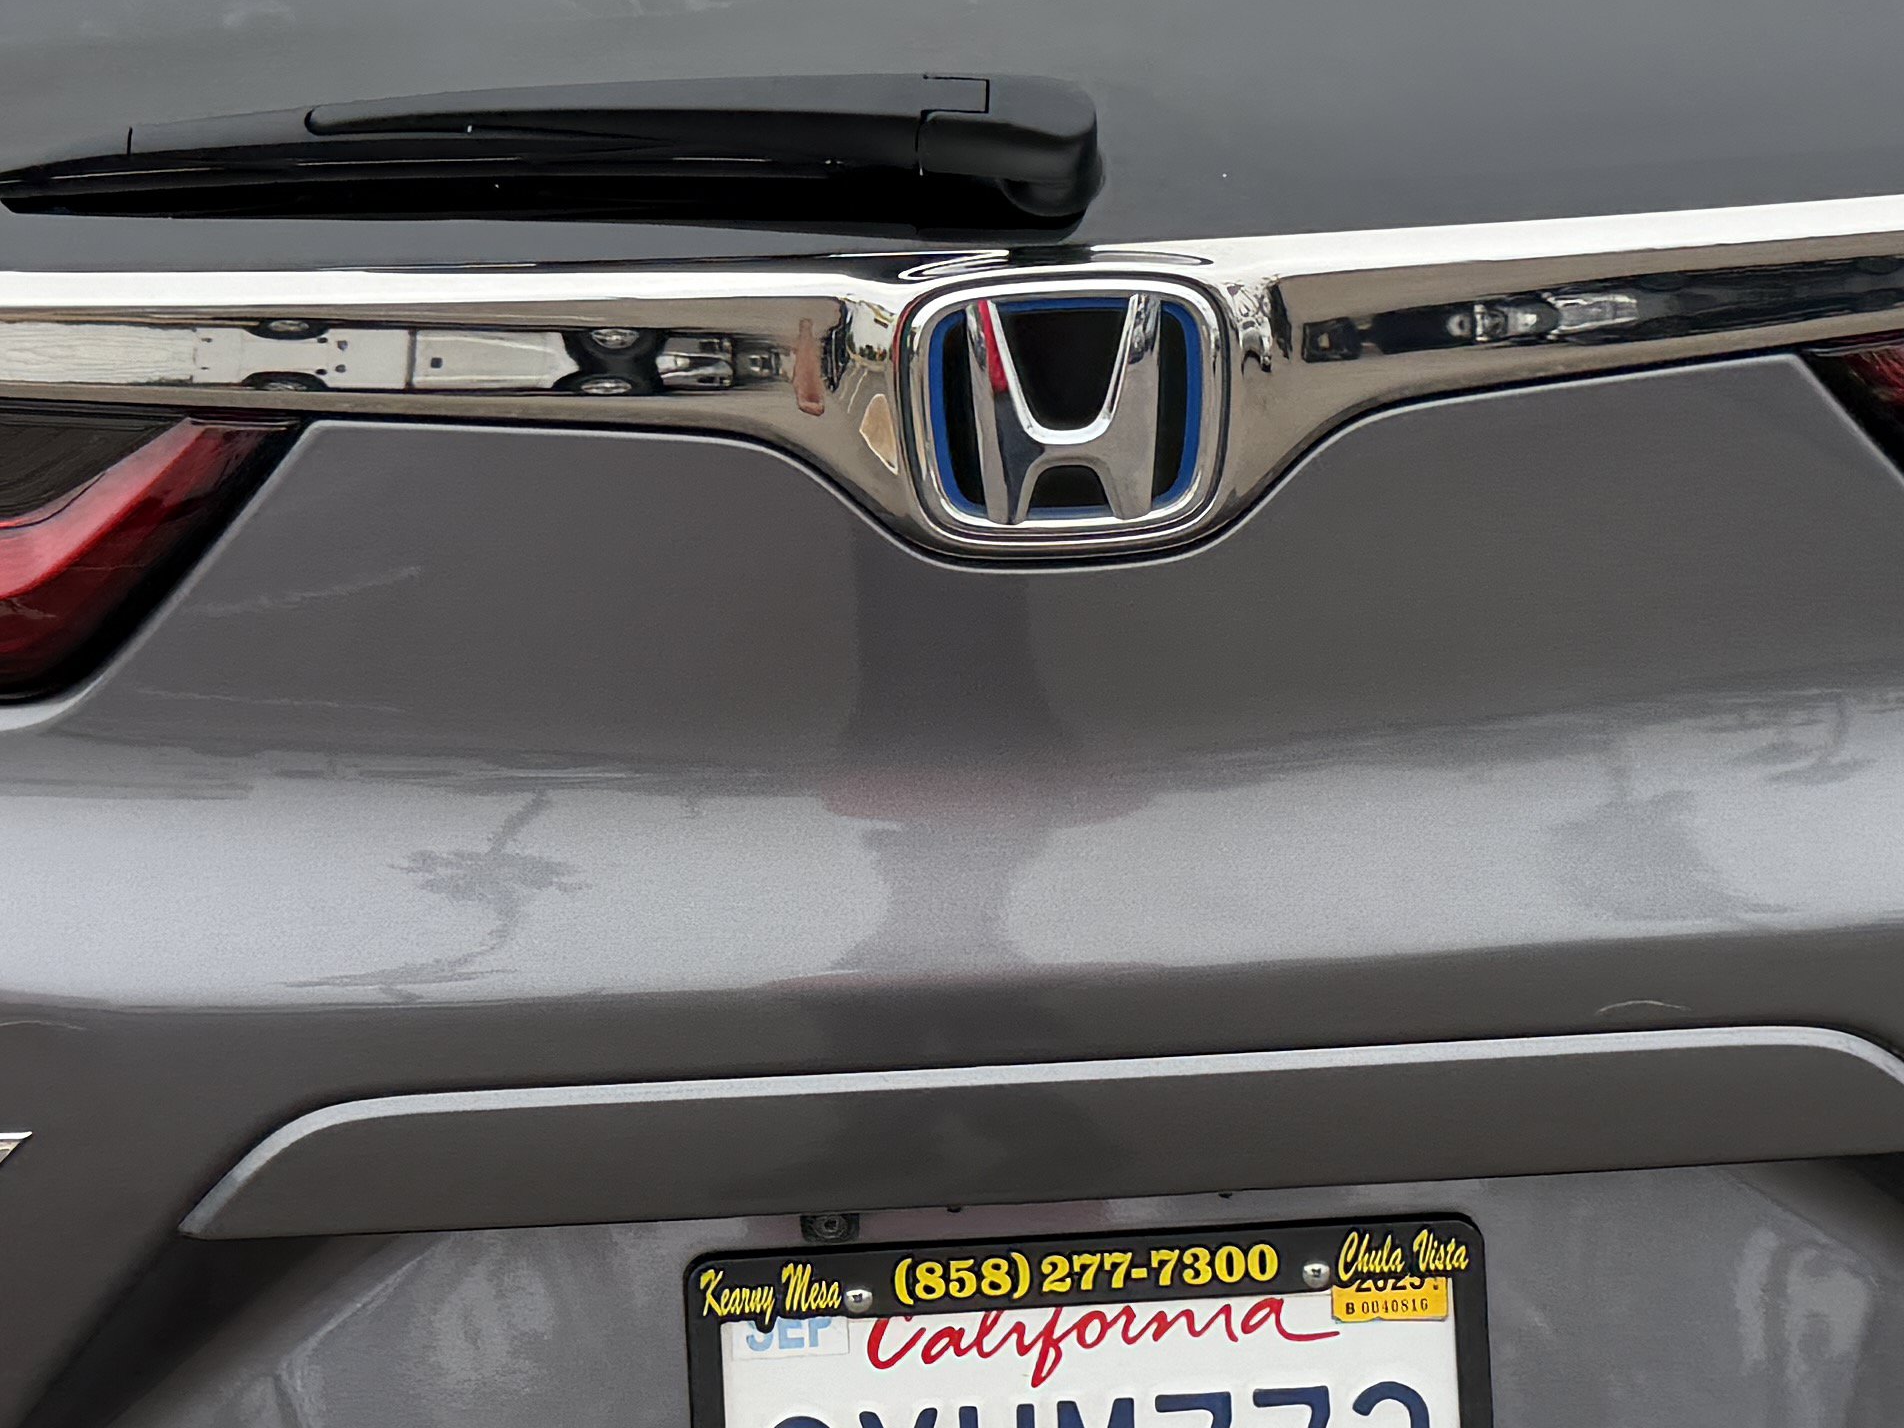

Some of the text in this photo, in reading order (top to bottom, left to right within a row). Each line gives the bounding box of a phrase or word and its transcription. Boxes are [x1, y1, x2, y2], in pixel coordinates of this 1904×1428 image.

[893, 1242, 1279, 1306] (858) 277-7300
[1338, 1228, 1469, 1281] Chula Vista
[700, 1262, 842, 1325] Kearny Mesa
[867, 1296, 1340, 1388] California
